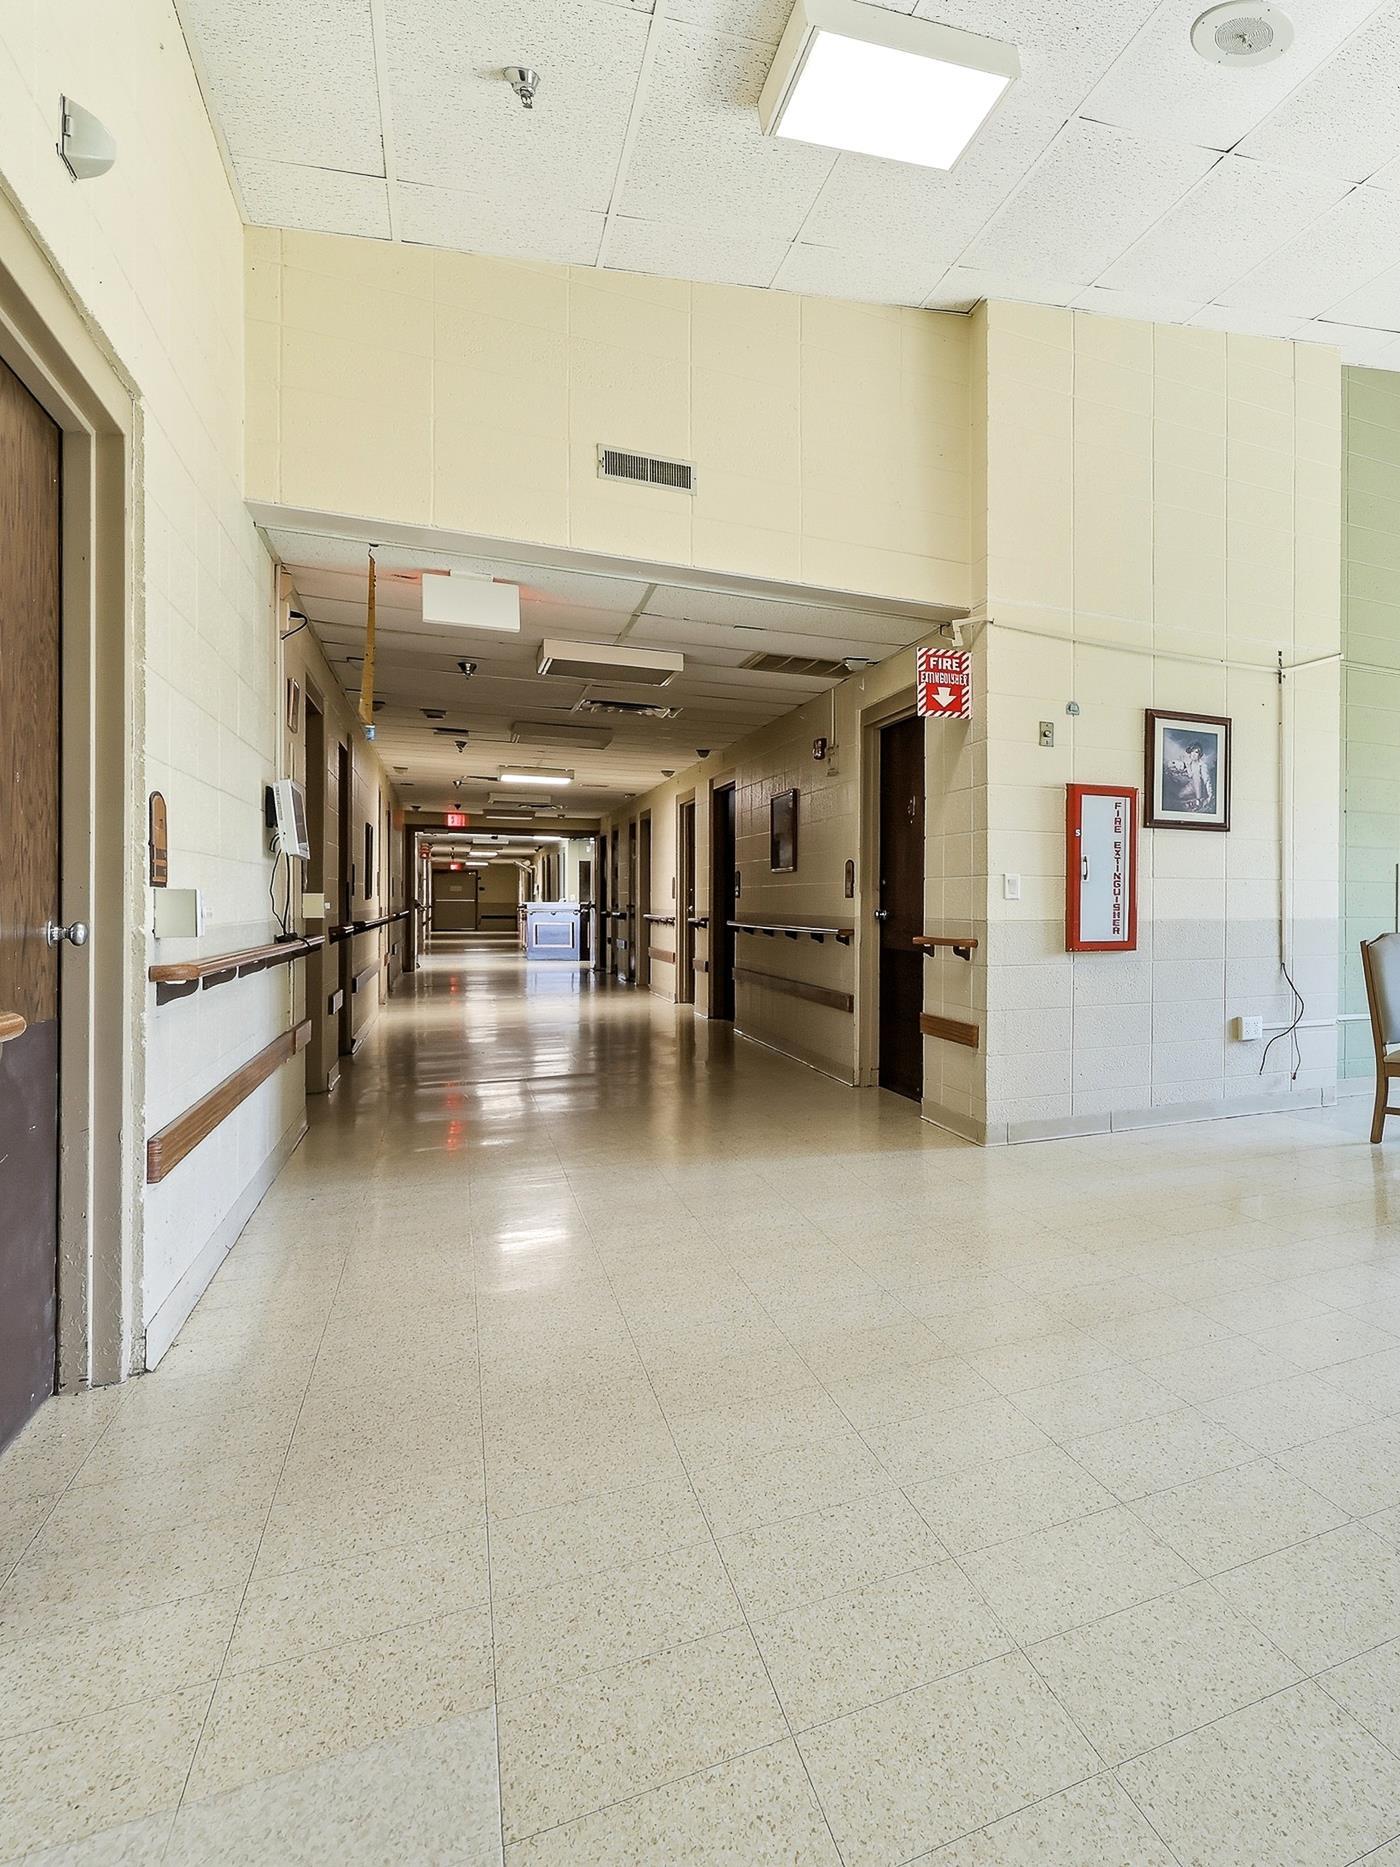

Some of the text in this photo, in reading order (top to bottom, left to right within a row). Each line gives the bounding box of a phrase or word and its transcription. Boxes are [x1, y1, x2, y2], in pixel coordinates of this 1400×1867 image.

[930, 657, 960, 671] FIRE
[1112, 802, 1122, 935] FIRE EXTINGUISHER
